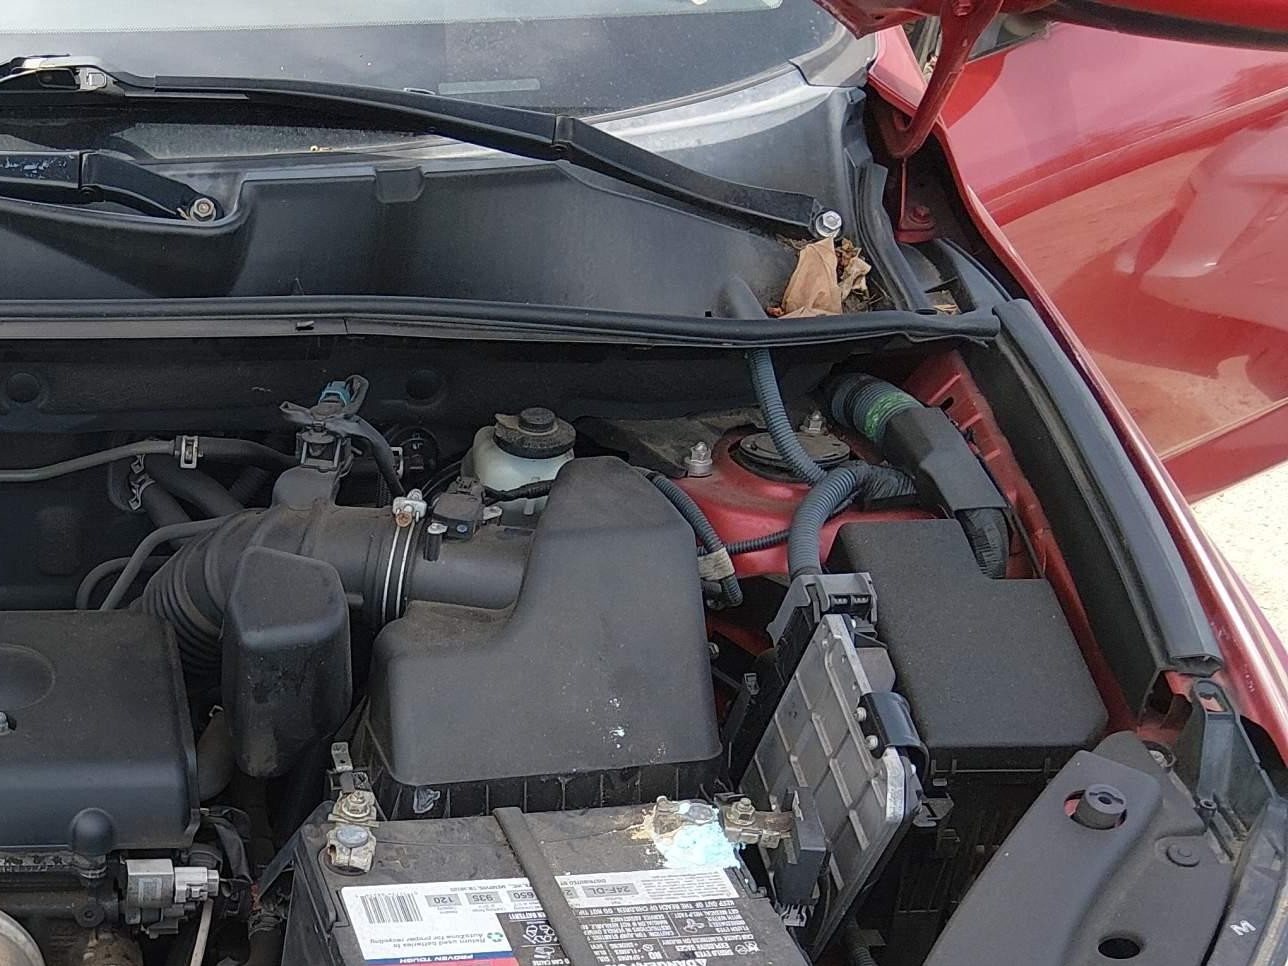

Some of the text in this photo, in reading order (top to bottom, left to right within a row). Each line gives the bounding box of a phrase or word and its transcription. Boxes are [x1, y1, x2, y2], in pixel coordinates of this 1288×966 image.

[588, 885, 630, 894] 24F-DL
[472, 893, 493, 901] 935
[513, 891, 534, 899] 650
[658, 903, 680, 911] REACH
[1229, 920, 1256, 936] M
[399, 955, 431, 963] TOUGH
[648, 951, 662, 959] NO
